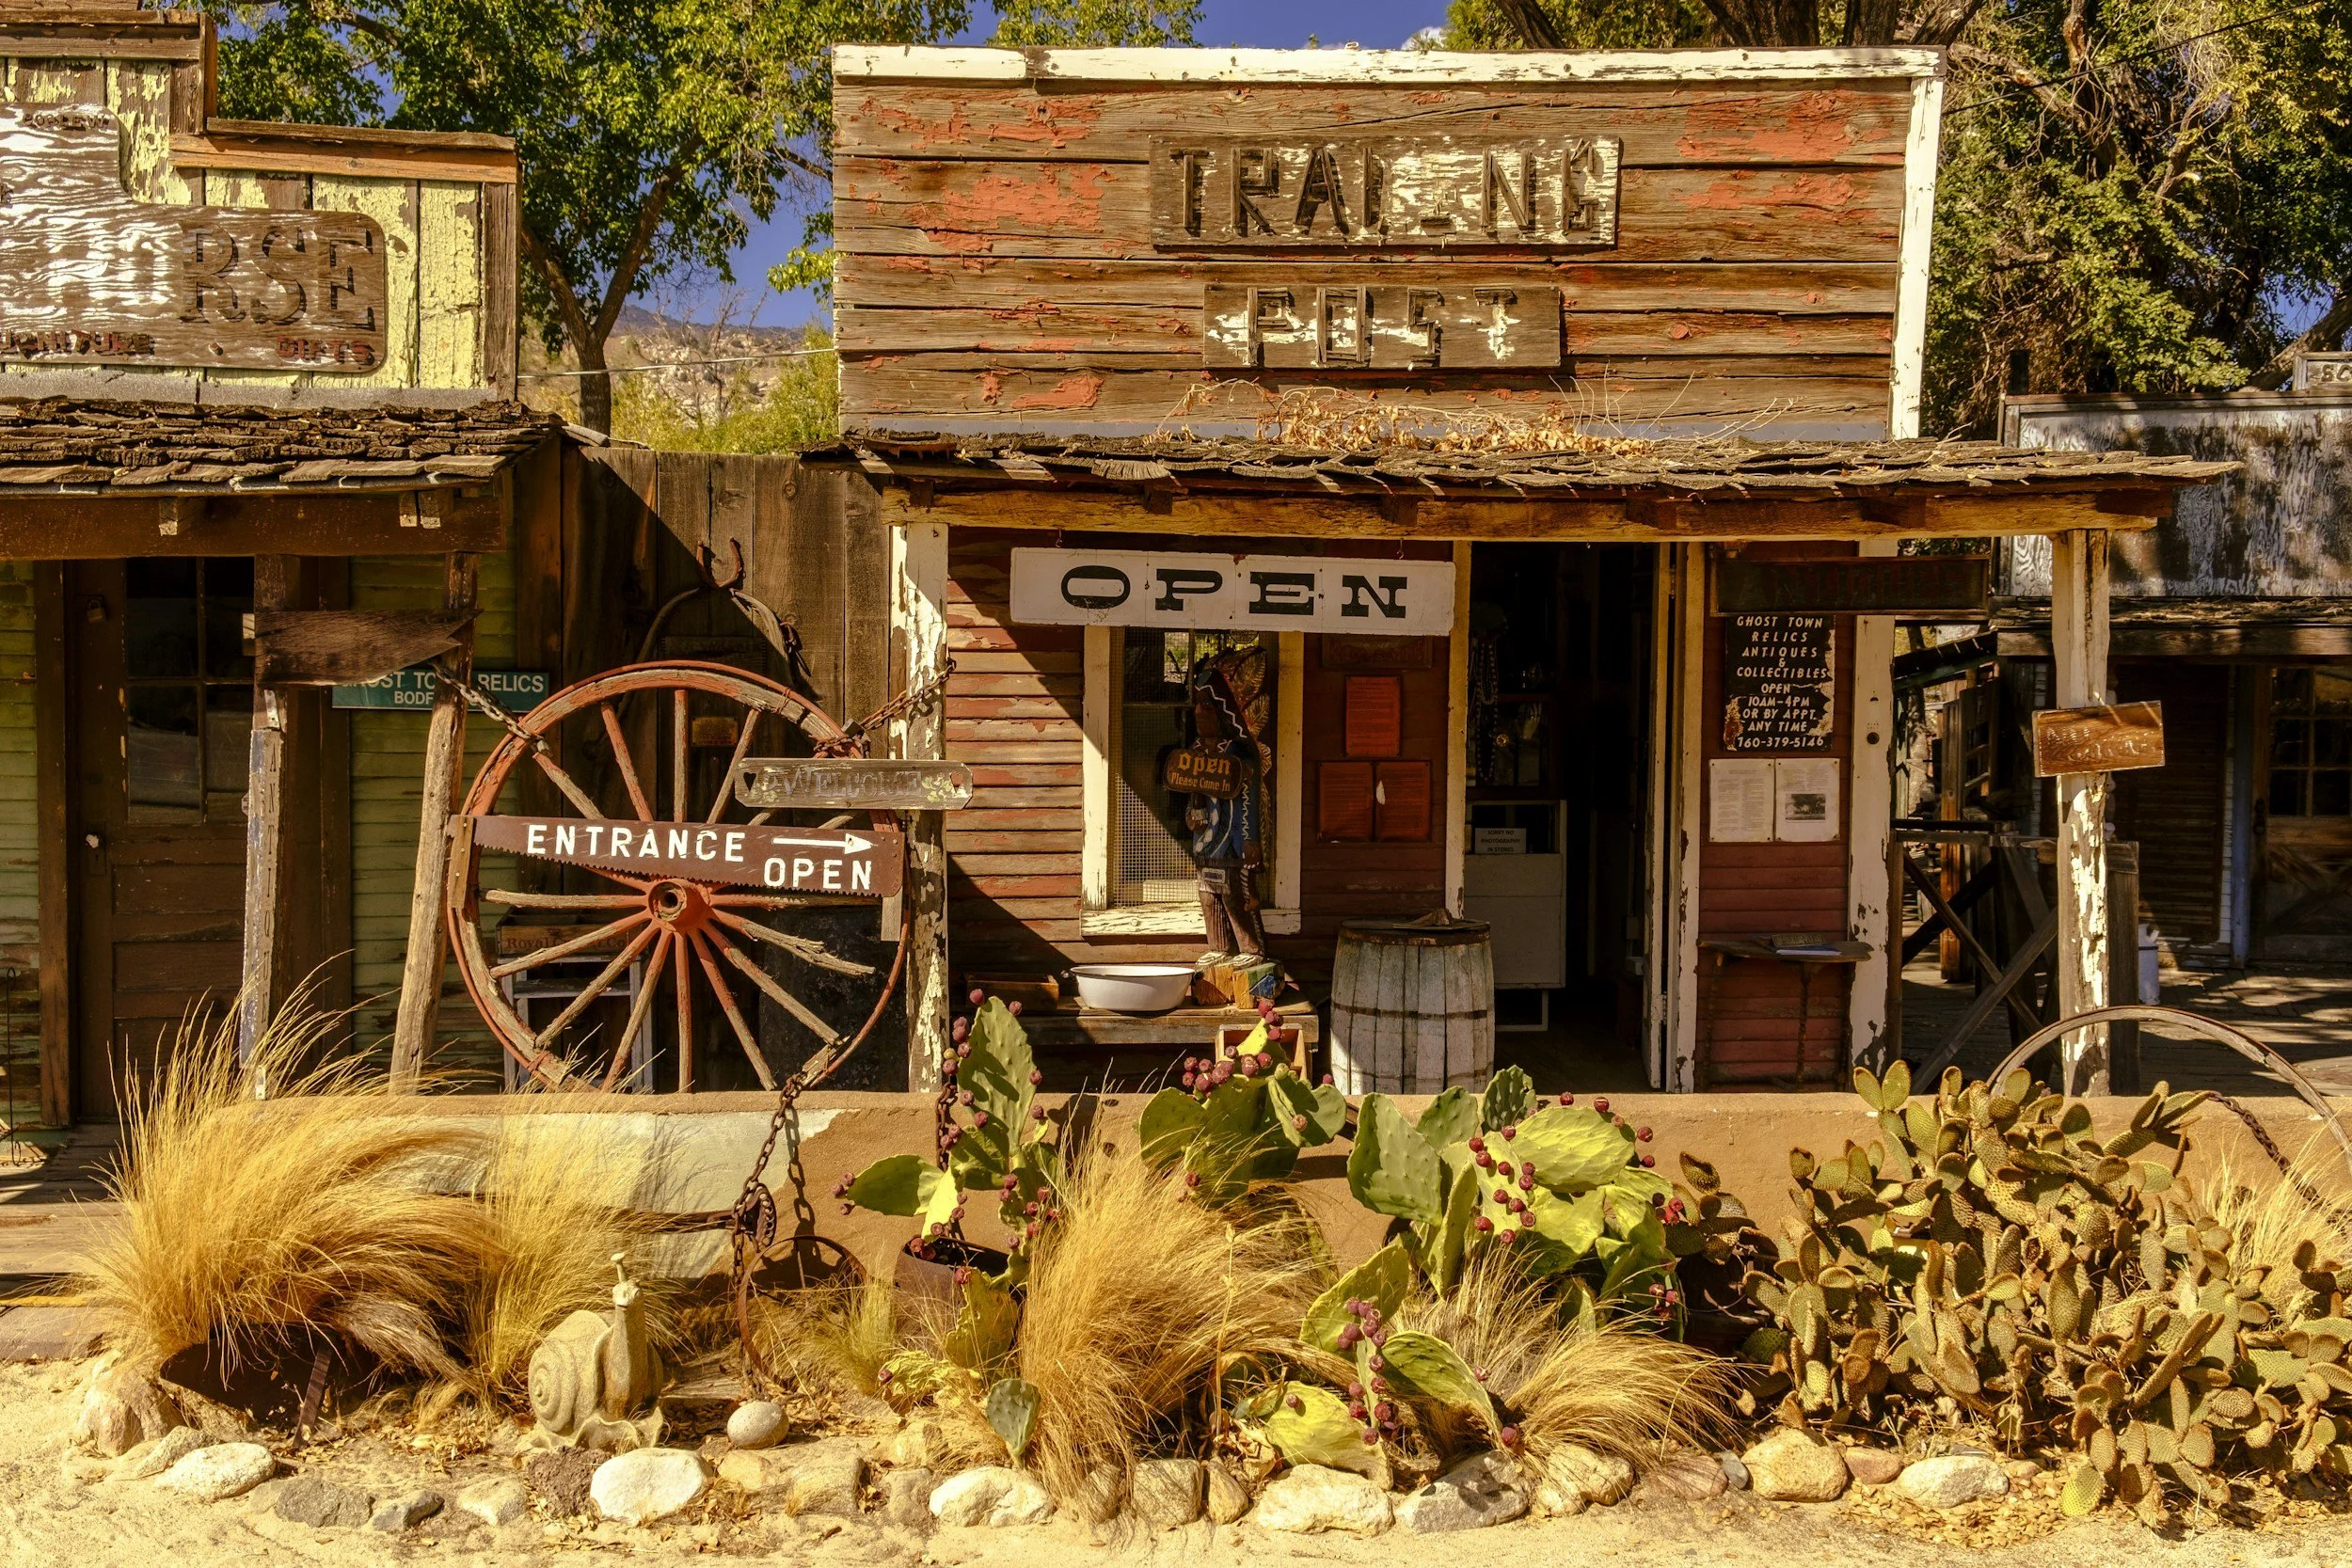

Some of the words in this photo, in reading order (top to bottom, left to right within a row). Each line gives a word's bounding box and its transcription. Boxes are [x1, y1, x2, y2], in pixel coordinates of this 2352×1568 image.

[1061, 565, 1407, 618] OPEN
[1737, 616, 1777, 627] GHOST
[1788, 617, 1823, 628] TOWN
[1752, 631, 1807, 642] RELICS
[1741, 646, 1818, 657] ANTIQUES
[1737, 667, 1827, 678] COLLECTIBLES
[1761, 684, 1790, 694] OPEN
[1742, 708, 1758, 719] OR
[1764, 709, 1778, 720] BY
[1783, 709, 1817, 720] APPT.
[1748, 721, 1772, 732] ANY
[1778, 721, 1807, 732] TIME
[1737, 736, 1824, 748] 760-379-5146
[1178, 752, 1231, 775] Open
[768, 767, 922, 798] WELCOME
[1171, 772, 1198, 787] Please
[1200, 777, 1220, 790] Come
[1222, 780, 1231, 792] In
[527, 825, 746, 863] ENTRANCE
[763, 857, 872, 891] OPEN
